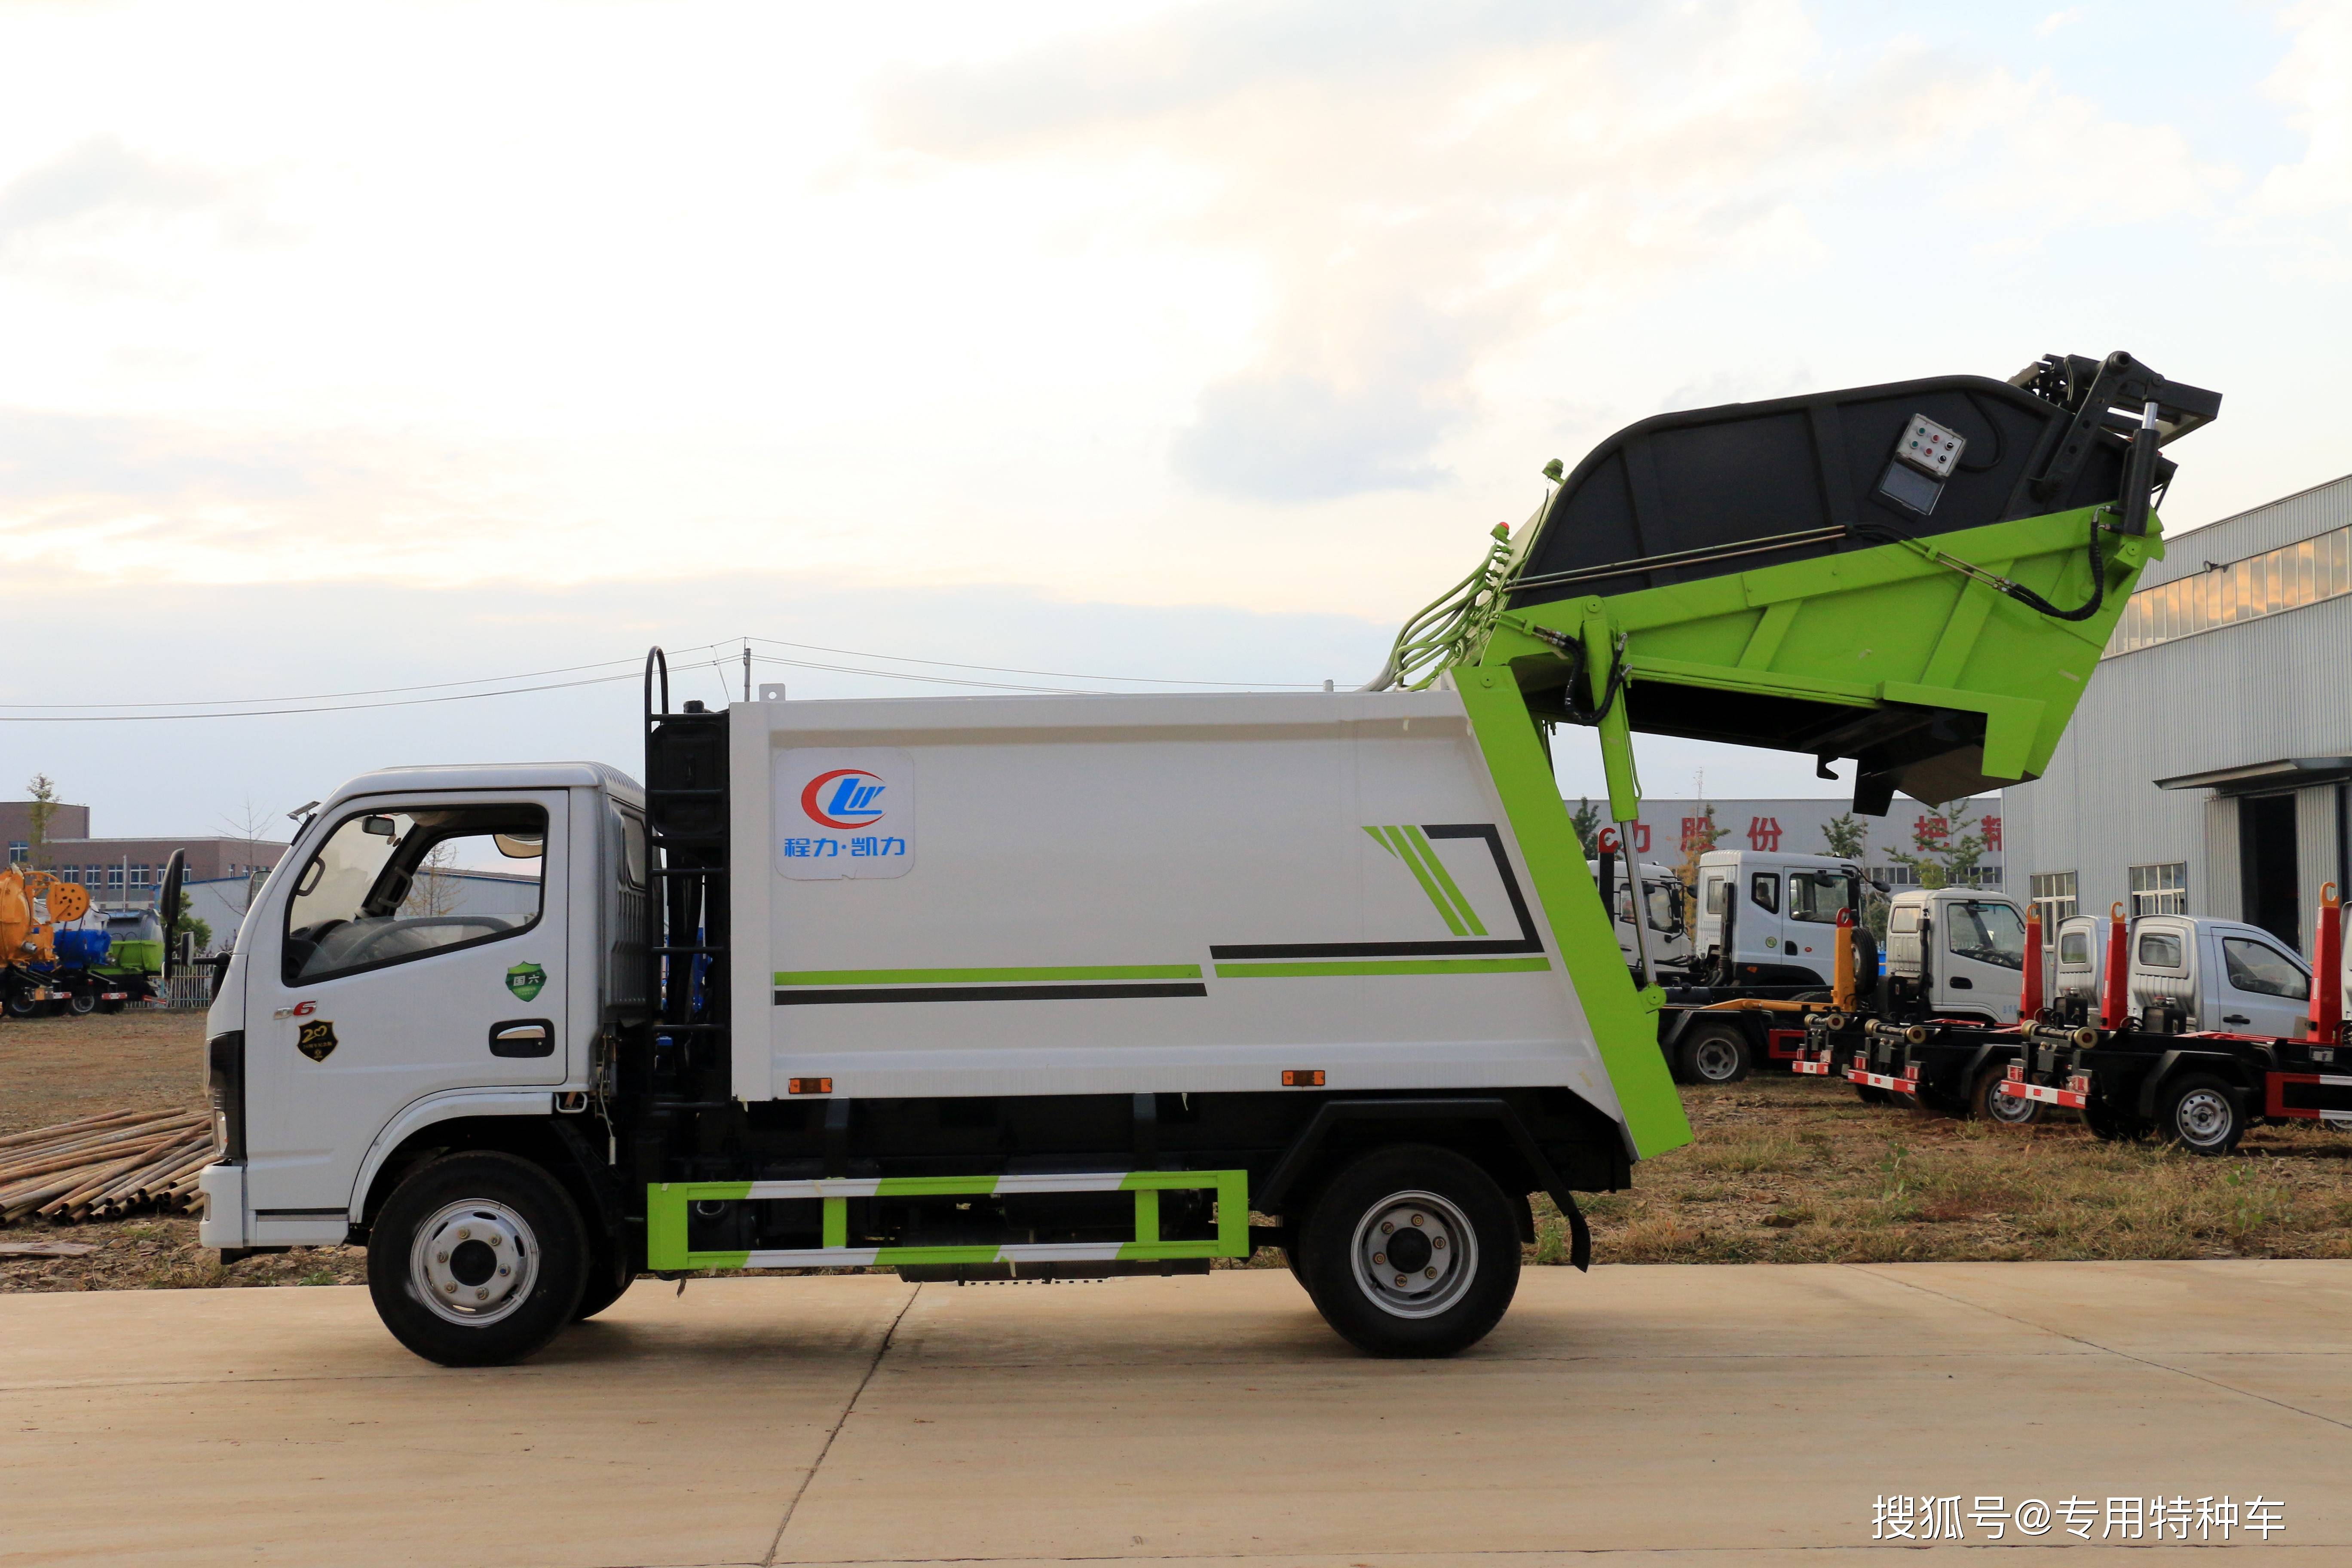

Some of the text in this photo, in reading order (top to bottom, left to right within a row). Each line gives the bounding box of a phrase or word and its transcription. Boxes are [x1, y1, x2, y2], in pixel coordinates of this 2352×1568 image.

[784, 836, 906, 858] 程力·凯力
[513, 974, 540, 986] 国六
